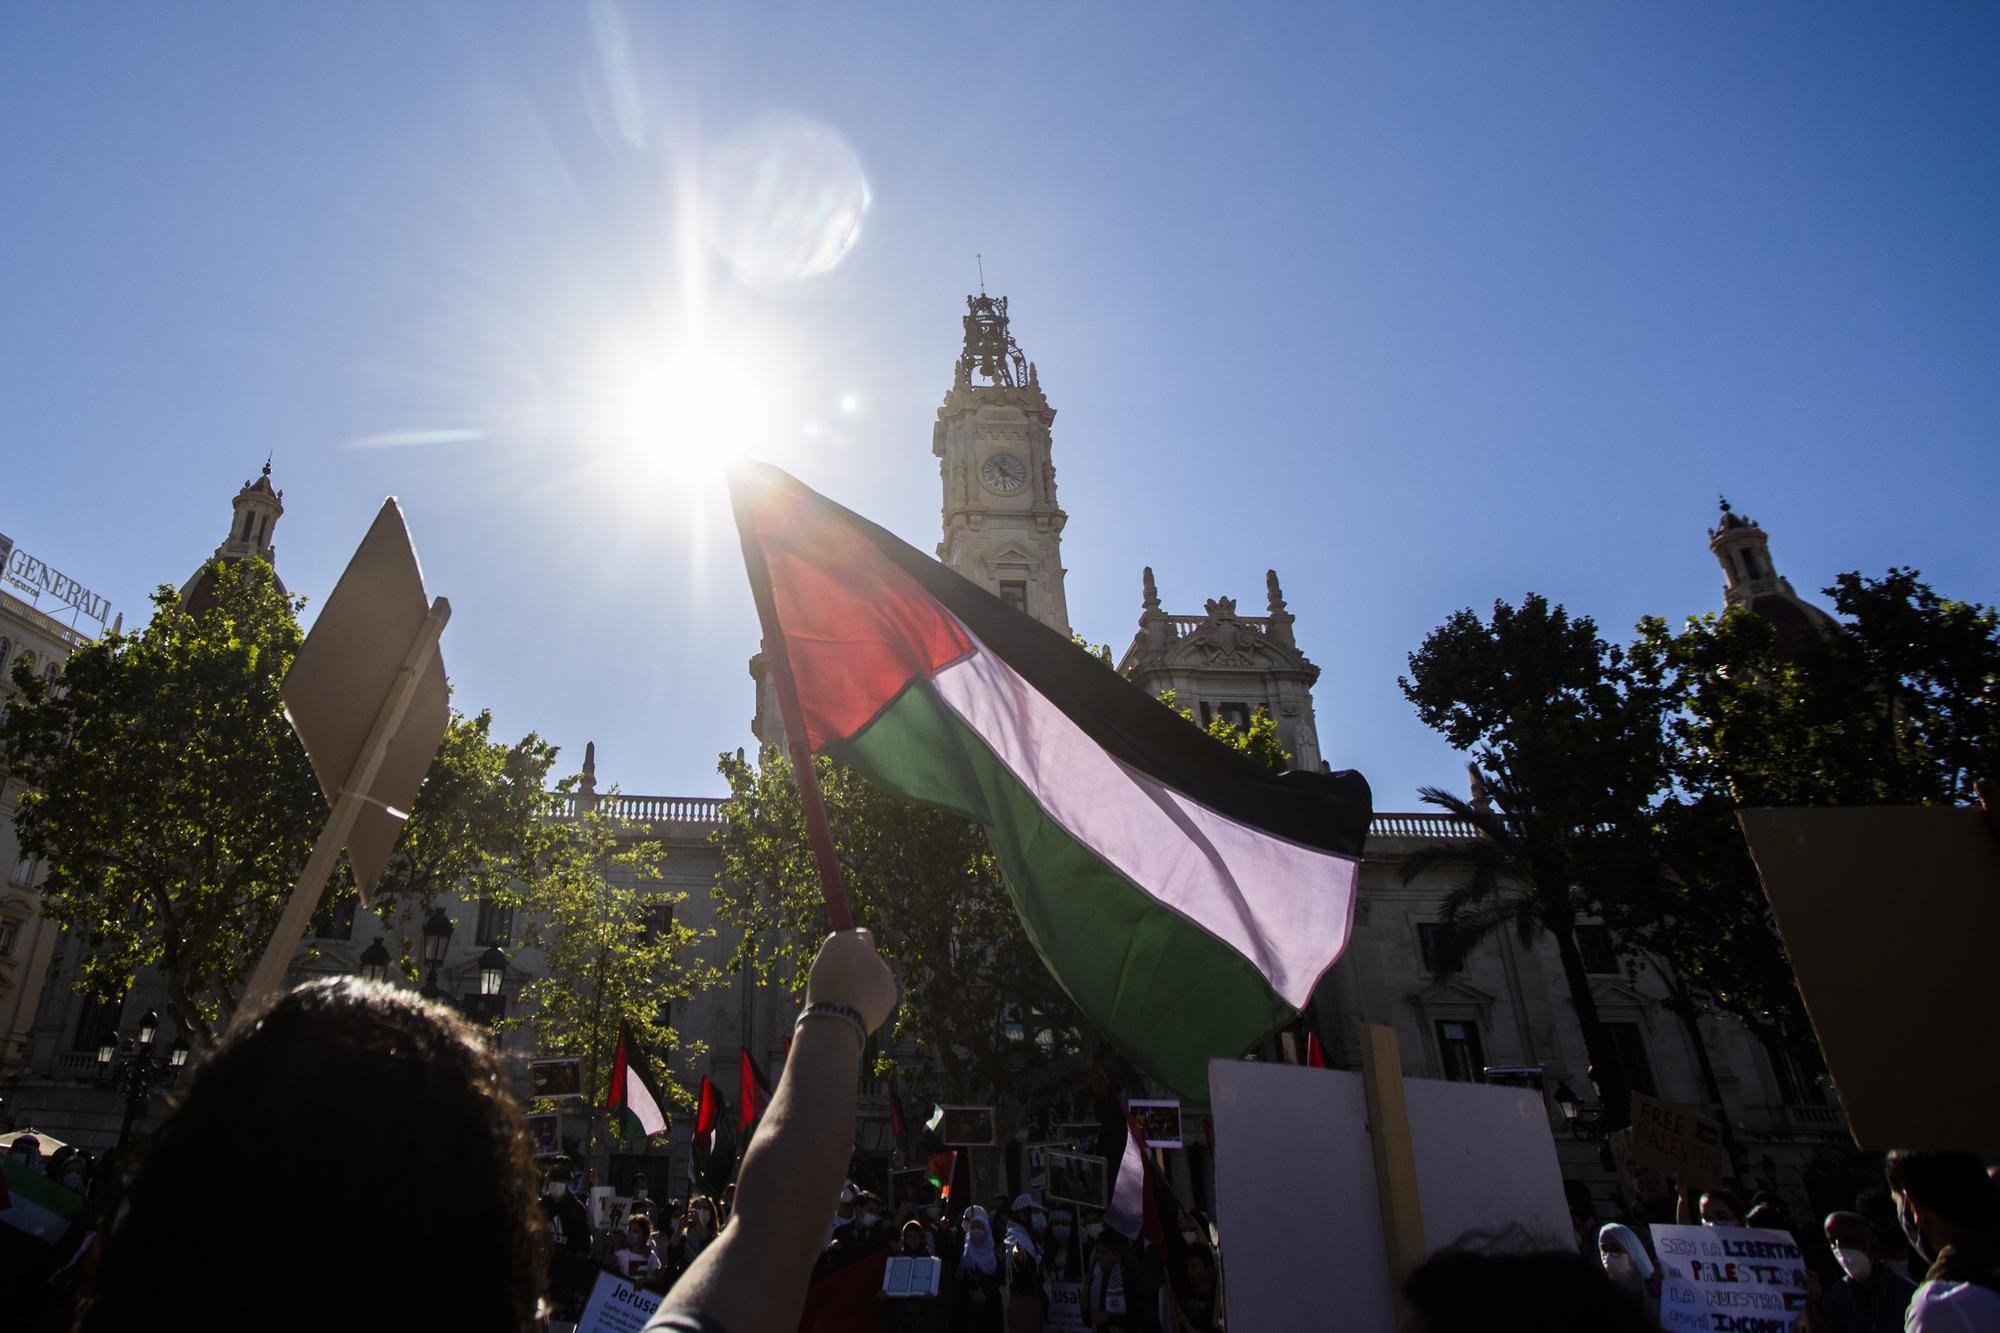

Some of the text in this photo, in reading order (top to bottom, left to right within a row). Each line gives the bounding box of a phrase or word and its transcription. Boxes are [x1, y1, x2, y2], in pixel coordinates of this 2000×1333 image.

[3, 569, 40, 598] Seguros
[9, 549, 112, 624] GENERALI
[1640, 1102, 1685, 1136] FREE
[1660, 1238, 1801, 1259] SIN LA LIBERTAD
[1691, 1260, 1806, 1286] PALESTINA
[611, 1283, 659, 1315] Jerusa
[1670, 1286, 1783, 1310] LA NUESTRA
